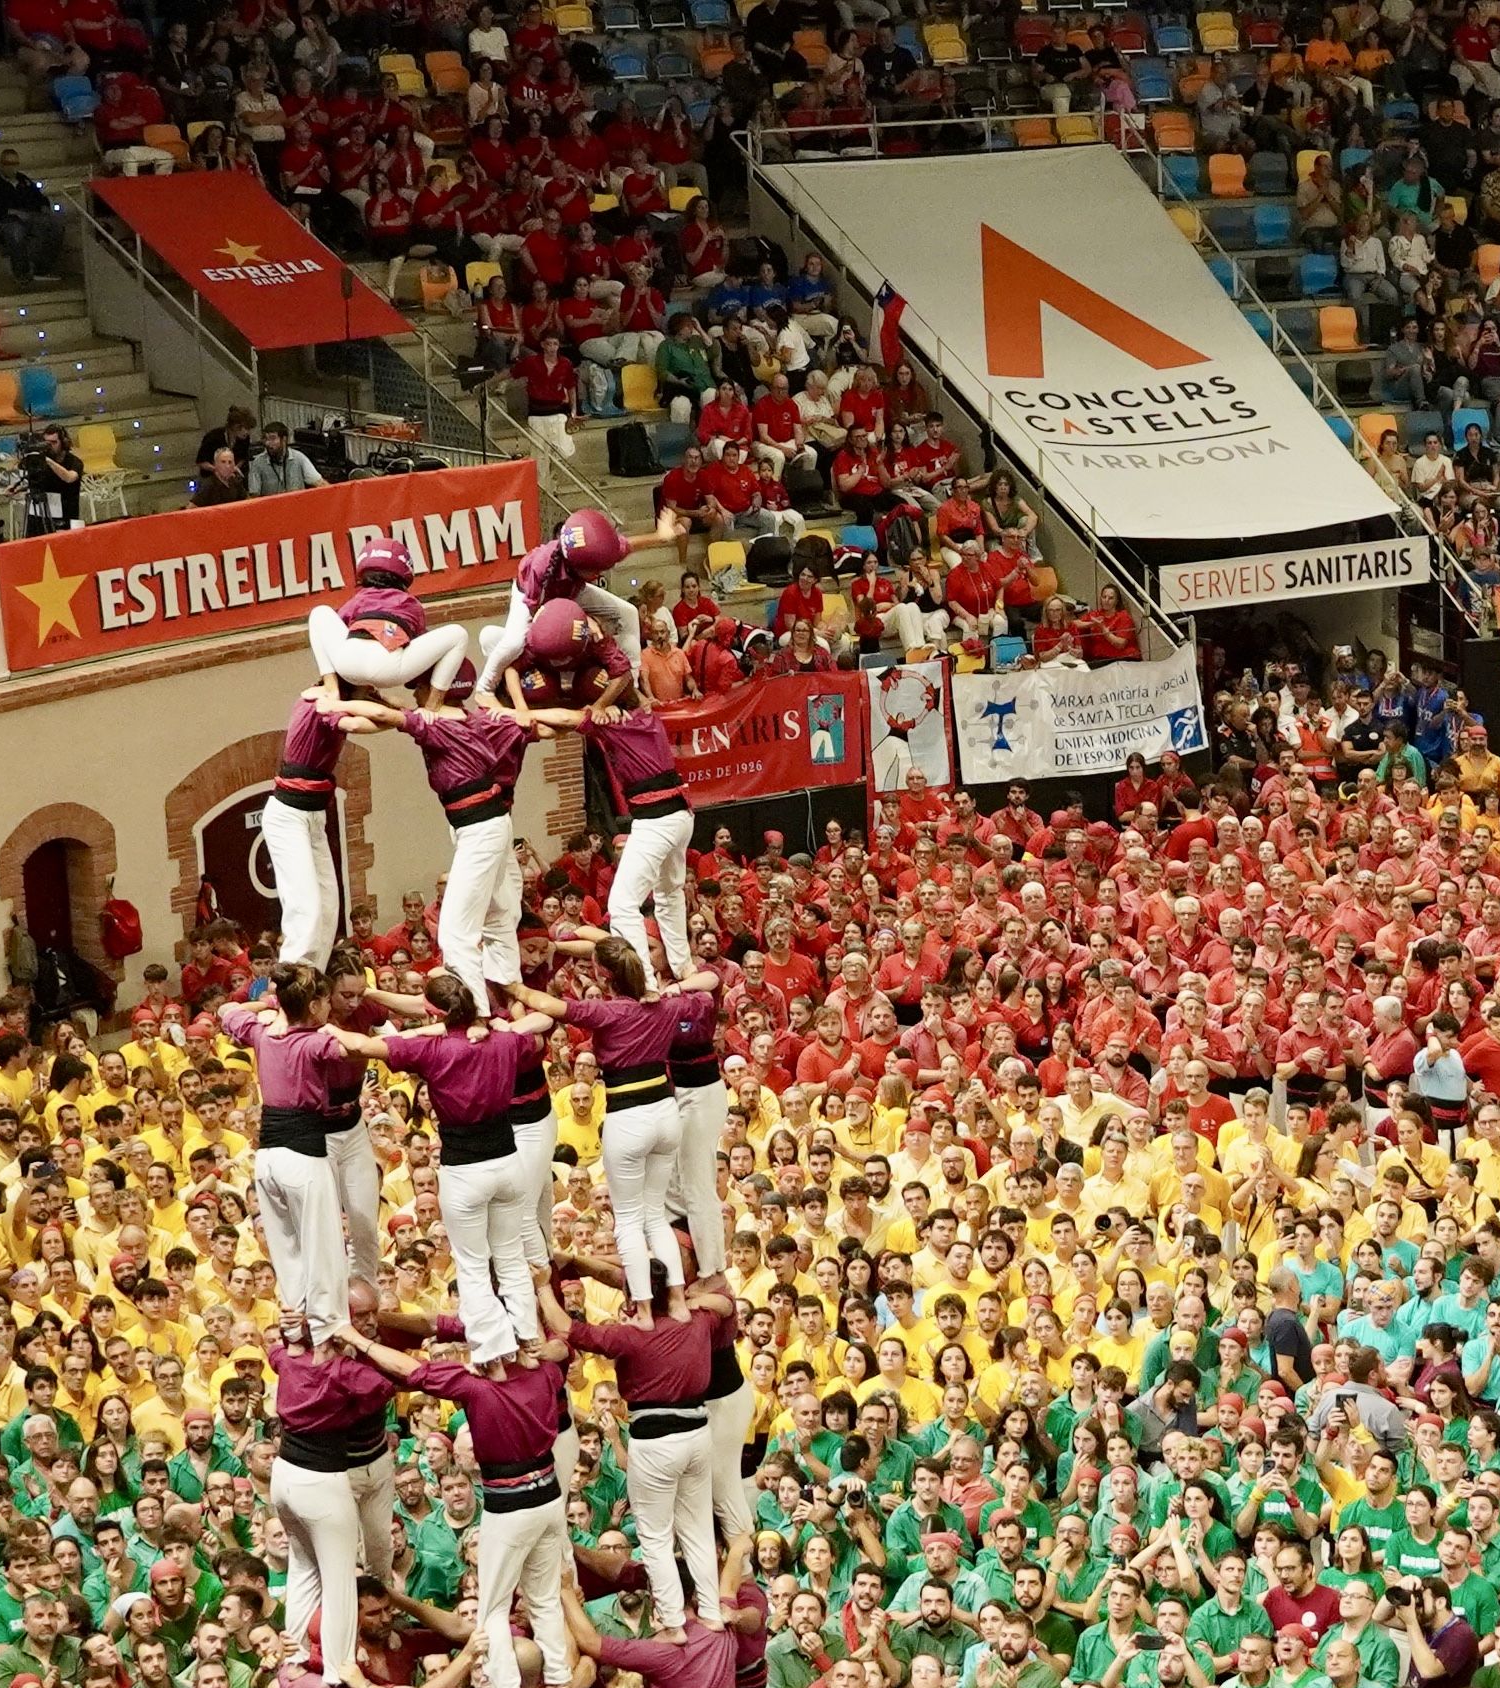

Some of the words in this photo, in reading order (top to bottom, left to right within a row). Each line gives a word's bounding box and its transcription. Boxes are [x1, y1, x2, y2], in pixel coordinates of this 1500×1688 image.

[201, 258, 324, 282] ESTRELLA
[252, 275, 295, 286] DAMM
[1005, 375, 1237, 411] CONCURS
[1025, 400, 1258, 435] CASTELLS
[1053, 438, 1292, 470] TARRAGONA
[96, 531, 346, 631] ESTRELLA
[1178, 563, 1275, 602] SERVEIS
[1285, 547, 1413, 590] SANITARIS
[1050, 693, 1095, 708] XARXA
[1068, 711, 1114, 728] SANTA
[1116, 703, 1156, 721] TECLA
[1055, 735, 1095, 750] UNITAT
[1099, 725, 1162, 746] MEDICINA
[688, 769, 713, 783] DES
[716, 766, 731, 779] DE
[736, 760, 763, 775] 1926
[1055, 753, 1073, 767] DE
